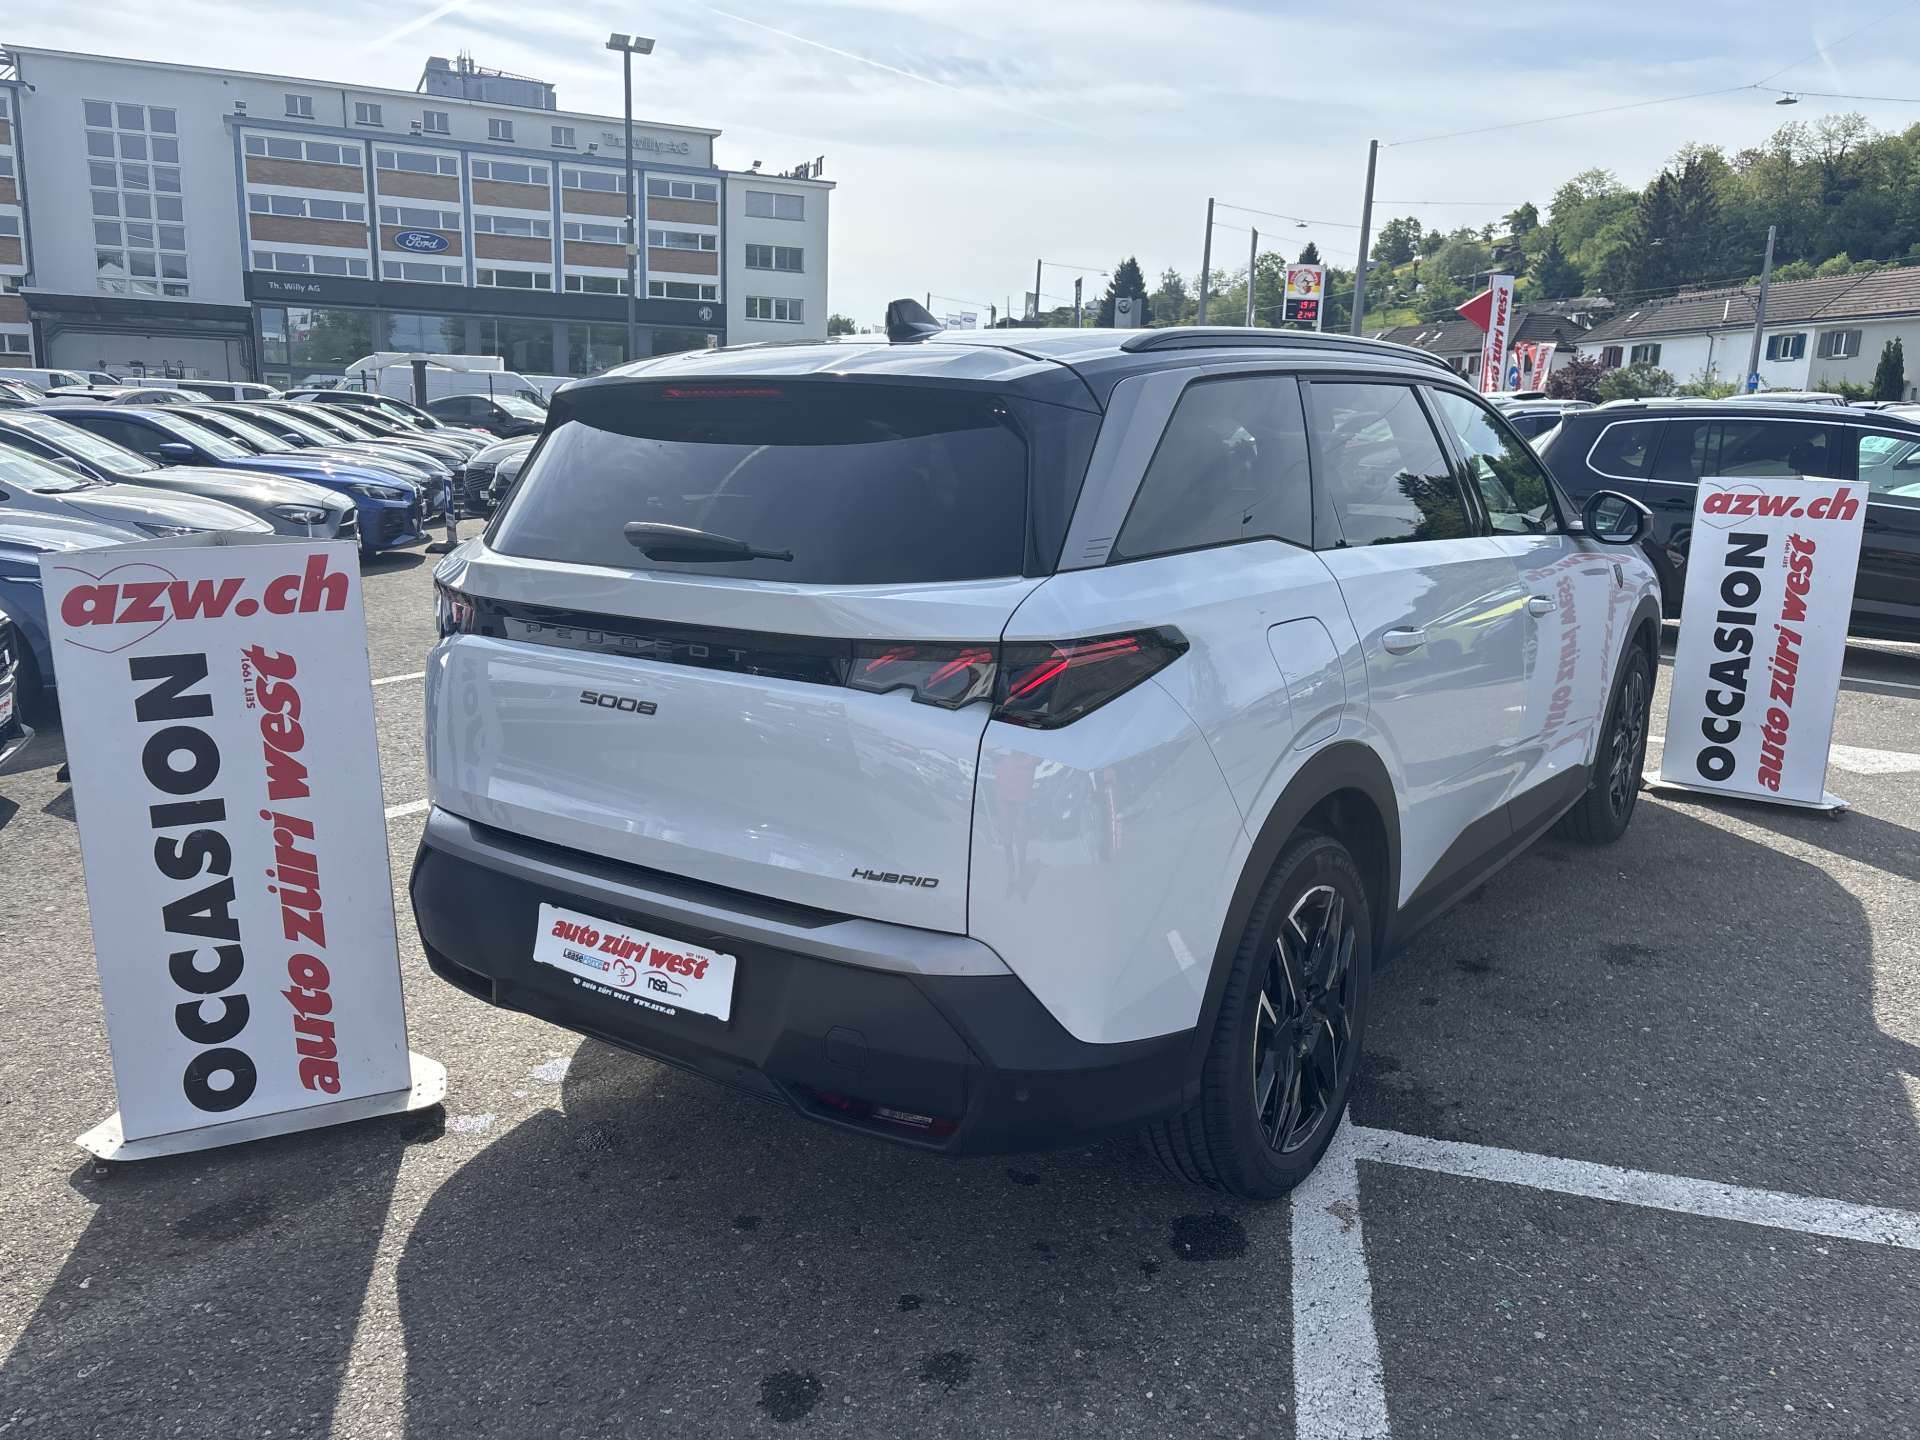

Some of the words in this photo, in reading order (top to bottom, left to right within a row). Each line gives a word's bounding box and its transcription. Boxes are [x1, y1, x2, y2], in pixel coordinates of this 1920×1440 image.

[404, 233, 438, 249] Ford
[284, 283, 305, 292] Willy
[308, 284, 320, 292] AG
[1703, 487, 1860, 521] azw.ch
[60, 554, 349, 628] azw.ch
[1781, 533, 1817, 622] west
[241, 658, 252, 682] 1991
[1696, 532, 1769, 782] OCCASION
[1767, 623, 1803, 708] züri
[240, 644, 310, 801] west
[246, 687, 256, 709] SEIT
[580, 690, 658, 715] 5008
[1758, 707, 1790, 792] auto
[128, 652, 257, 1113] OCCASION
[259, 808, 327, 949] züri
[851, 868, 940, 889] HYBRID
[551, 919, 600, 948] auto
[598, 934, 650, 963] züri
[649, 948, 710, 979] west
[581, 981, 597, 990] auto
[647, 976, 668, 992] nsa
[280, 954, 341, 1095] auto
